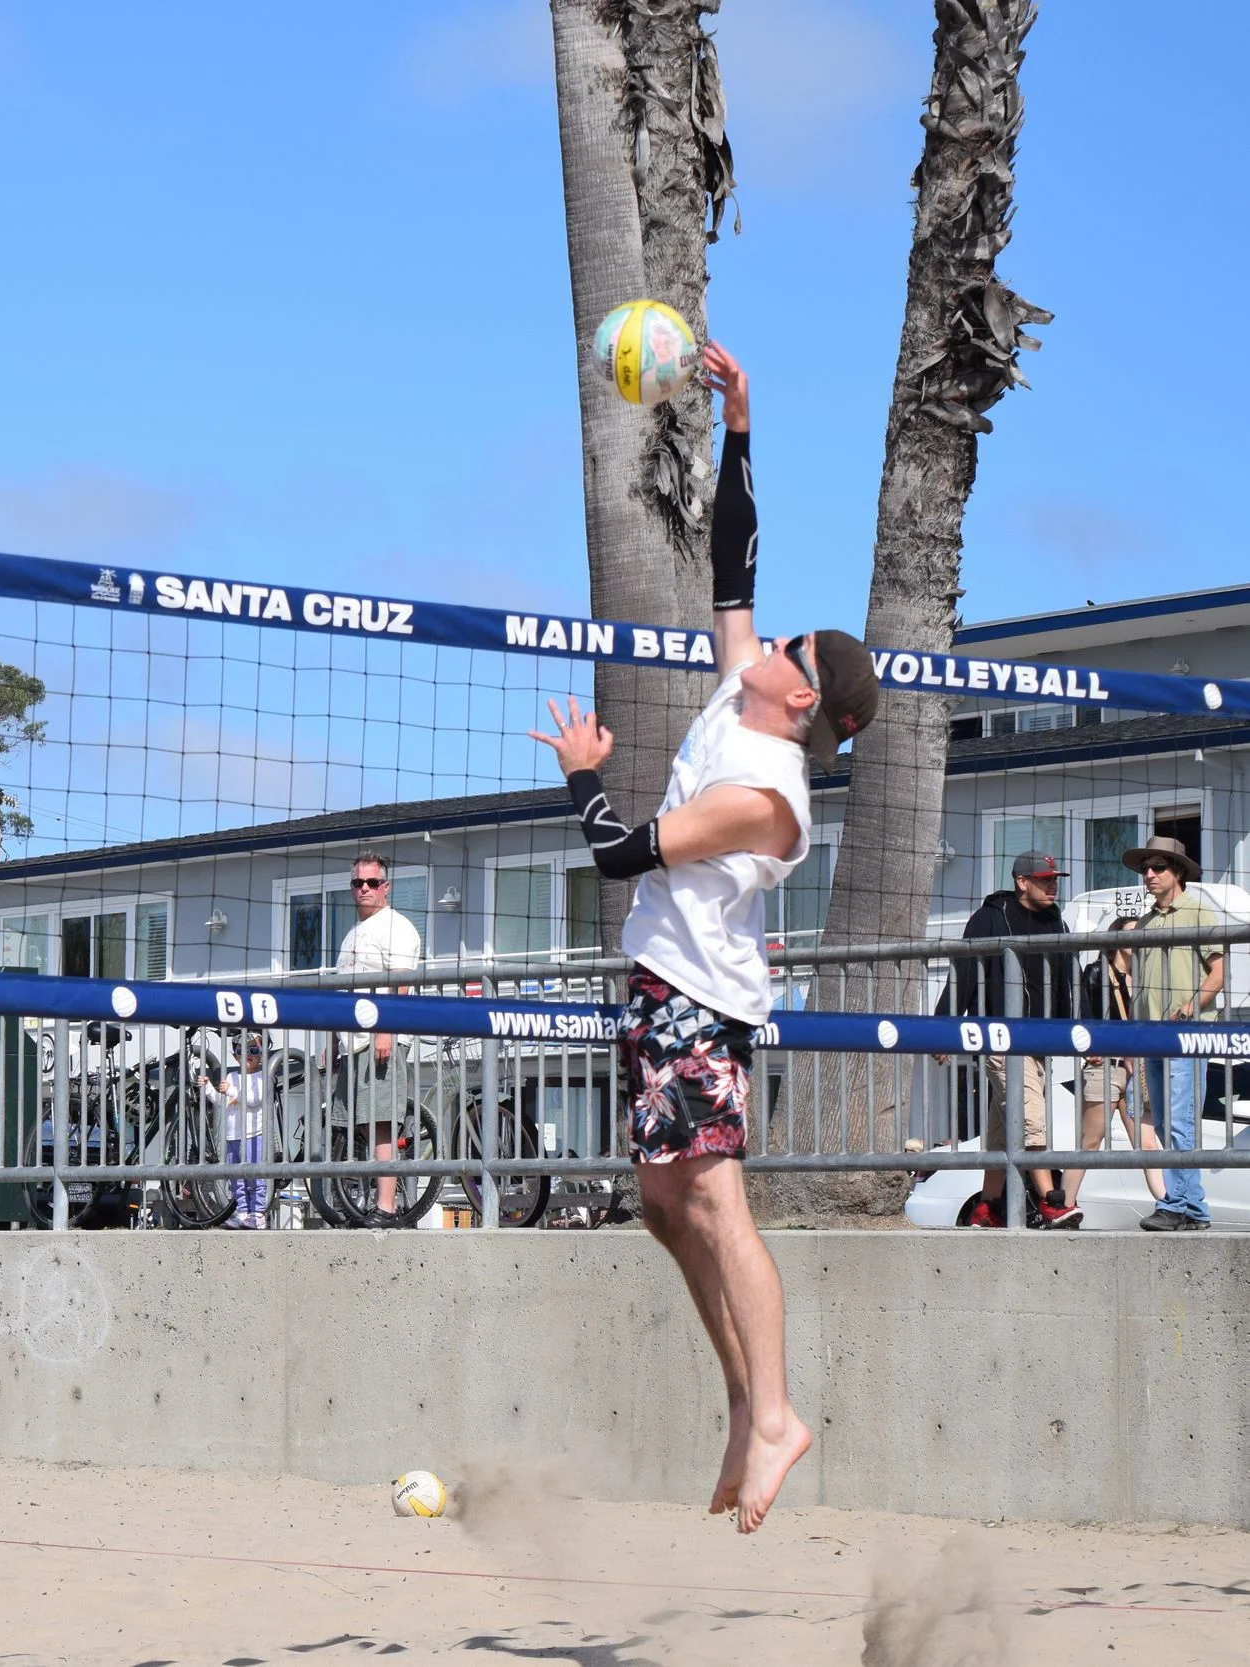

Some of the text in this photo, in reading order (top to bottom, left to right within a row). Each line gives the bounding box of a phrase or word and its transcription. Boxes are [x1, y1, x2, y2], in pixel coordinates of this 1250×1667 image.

[155, 575, 292, 621] SANTA
[303, 593, 413, 634] CRUZ
[505, 615, 614, 655] MAIN
[870, 651, 1109, 700] VOLLEYBALL
[396, 1481, 419, 1499] Wilson
